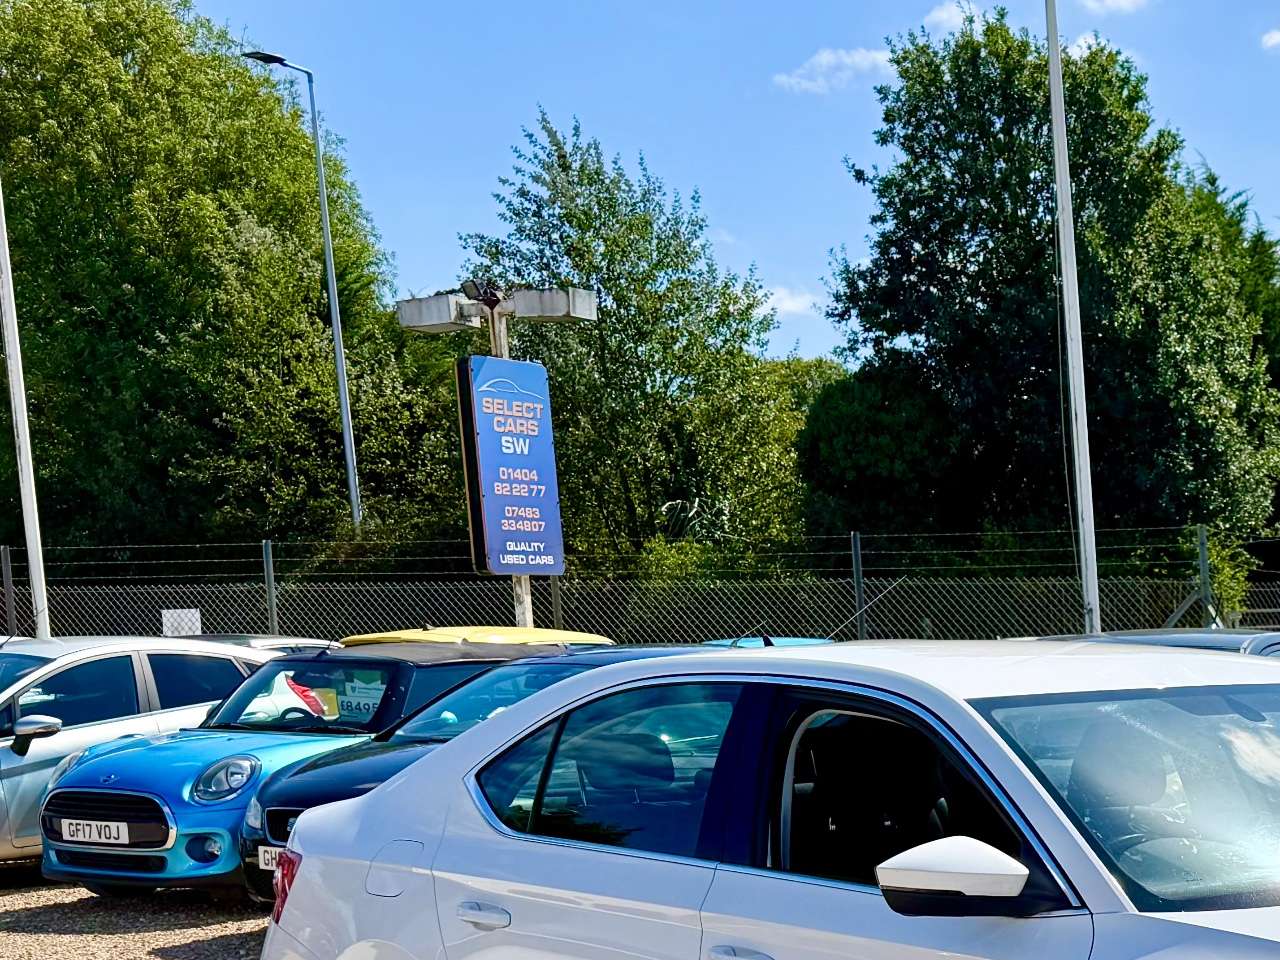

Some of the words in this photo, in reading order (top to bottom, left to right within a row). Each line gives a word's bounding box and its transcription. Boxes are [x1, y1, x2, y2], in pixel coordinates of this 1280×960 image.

[482, 398, 544, 419] SELECT
[493, 418, 539, 436] CARS
[501, 436, 530, 455] SW
[499, 467, 538, 481] 01404
[506, 541, 545, 552] QUALITY
[500, 554, 527, 564] USED
[528, 555, 554, 565] CARS
[68, 822, 93, 840] GF17
[95, 823, 120, 841] VOJ
